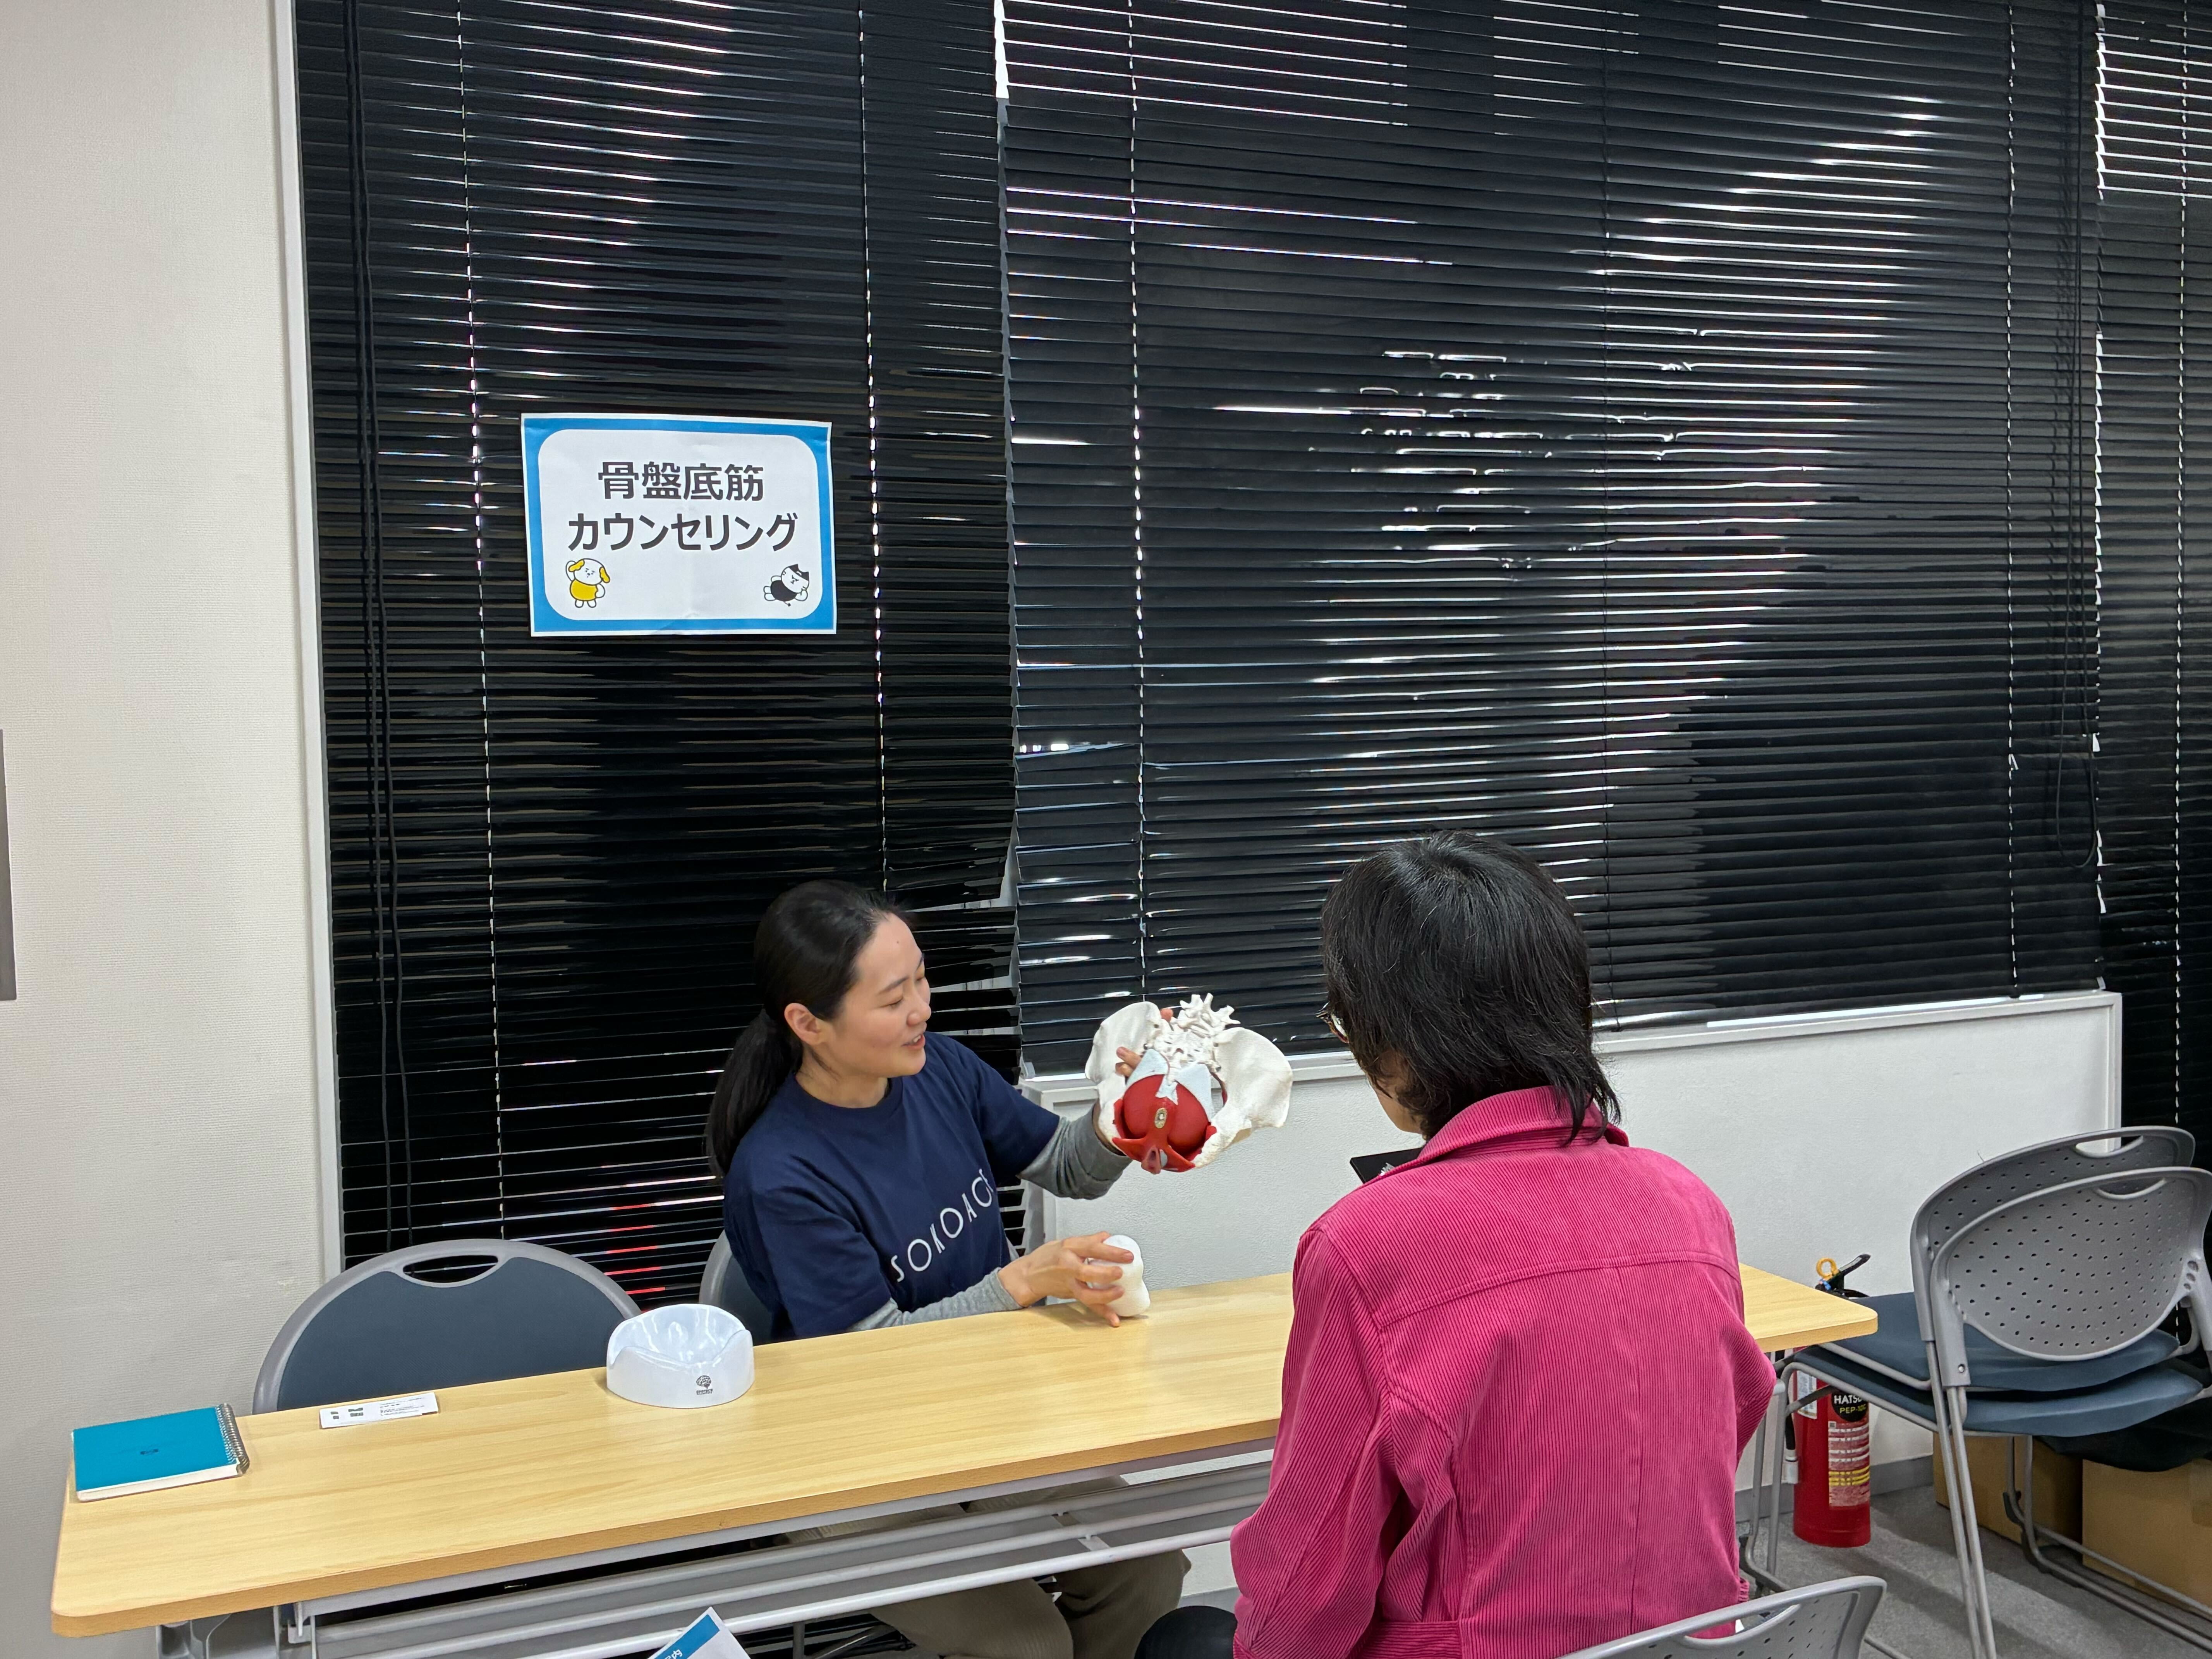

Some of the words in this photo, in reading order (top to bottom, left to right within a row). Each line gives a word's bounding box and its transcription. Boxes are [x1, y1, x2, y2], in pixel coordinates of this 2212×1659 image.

[598, 461, 764, 501] 骨盤底筋
[568, 512, 799, 551] カウンセリング
